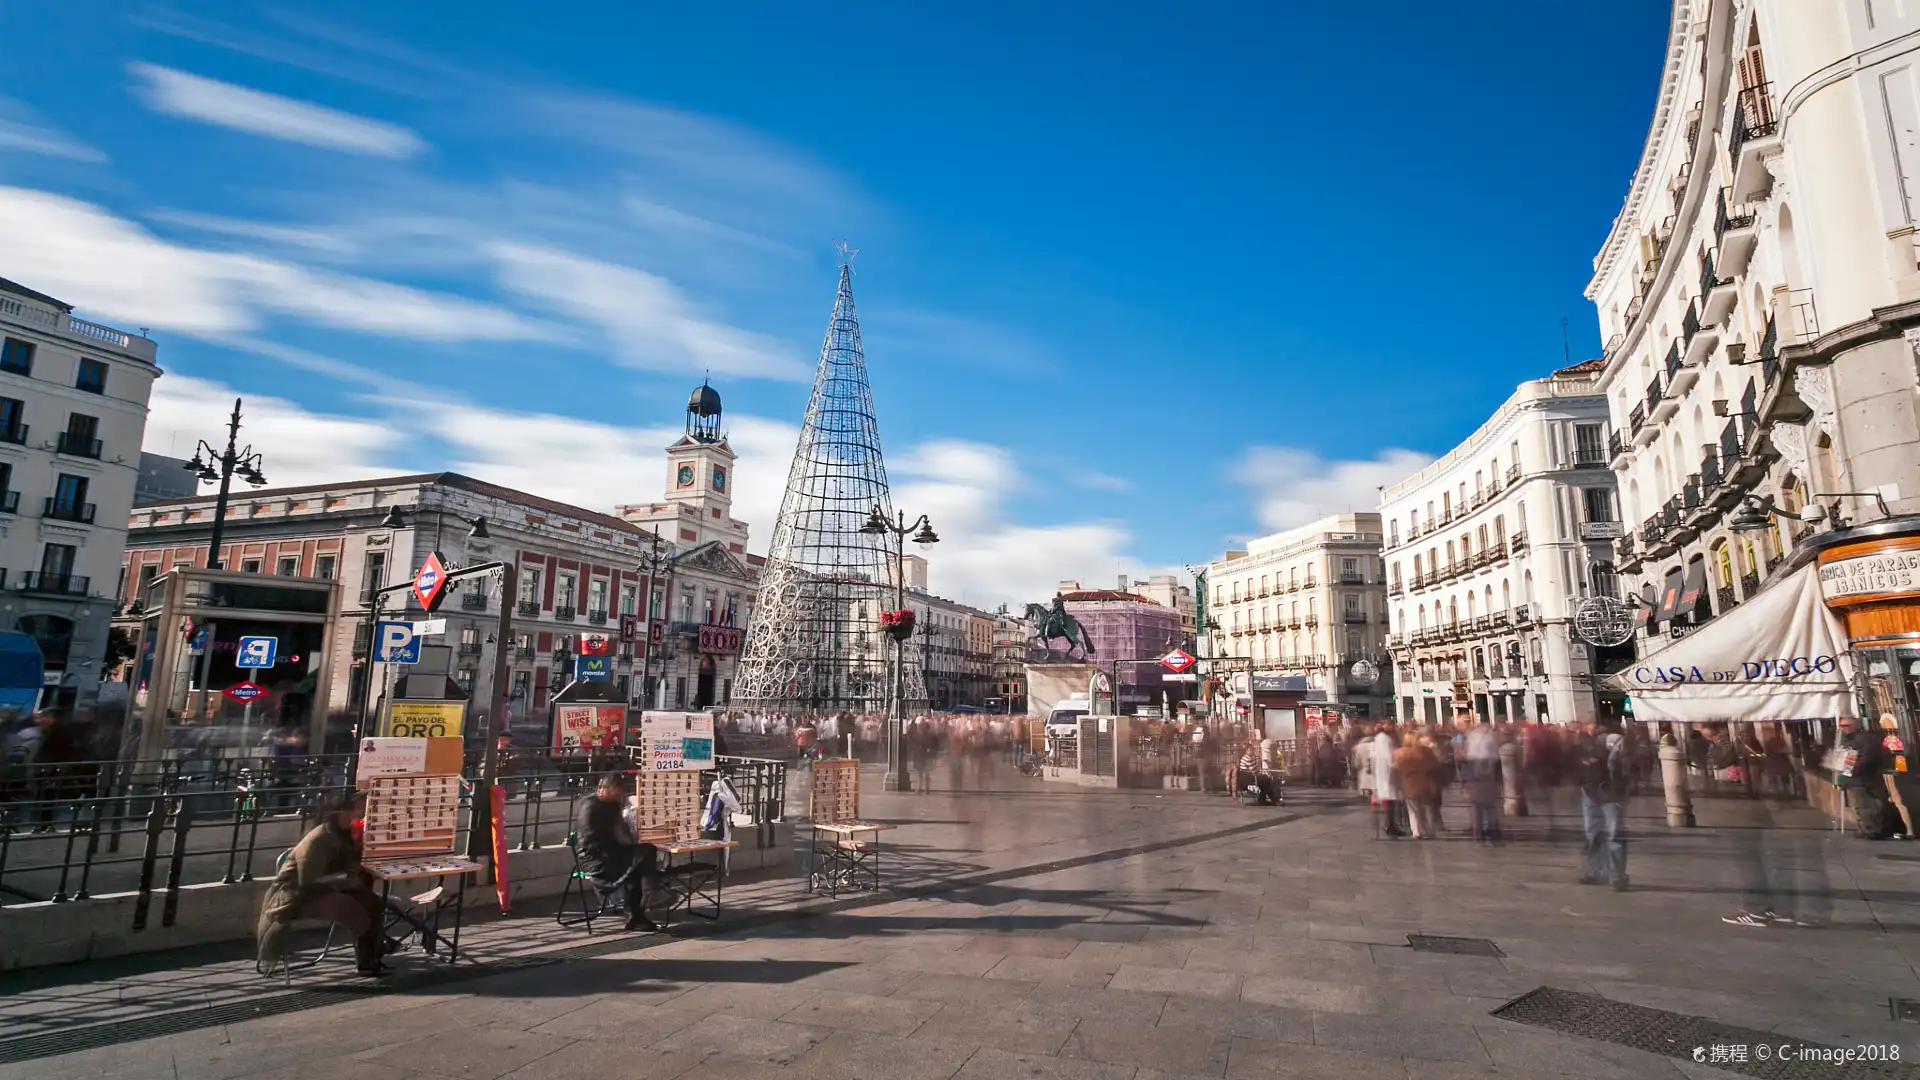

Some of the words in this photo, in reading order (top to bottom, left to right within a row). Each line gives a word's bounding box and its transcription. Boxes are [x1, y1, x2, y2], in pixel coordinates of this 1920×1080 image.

[1849, 561, 1865, 577] DE
[1868, 553, 1920, 574] PARAG
[1835, 572, 1912, 594] ABANICOS
[1671, 625, 1698, 637] CHAN
[1634, 665, 1705, 684] CASA
[1713, 670, 1735, 681] DE
[1742, 655, 1836, 680] DIEGO
[393, 716, 404, 724] EL
[406, 716, 430, 724] PAYO
[431, 716, 447, 724] DEL
[568, 717, 591, 728] WISE
[392, 724, 446, 737] ORO
[656, 760, 684, 769] 02184
